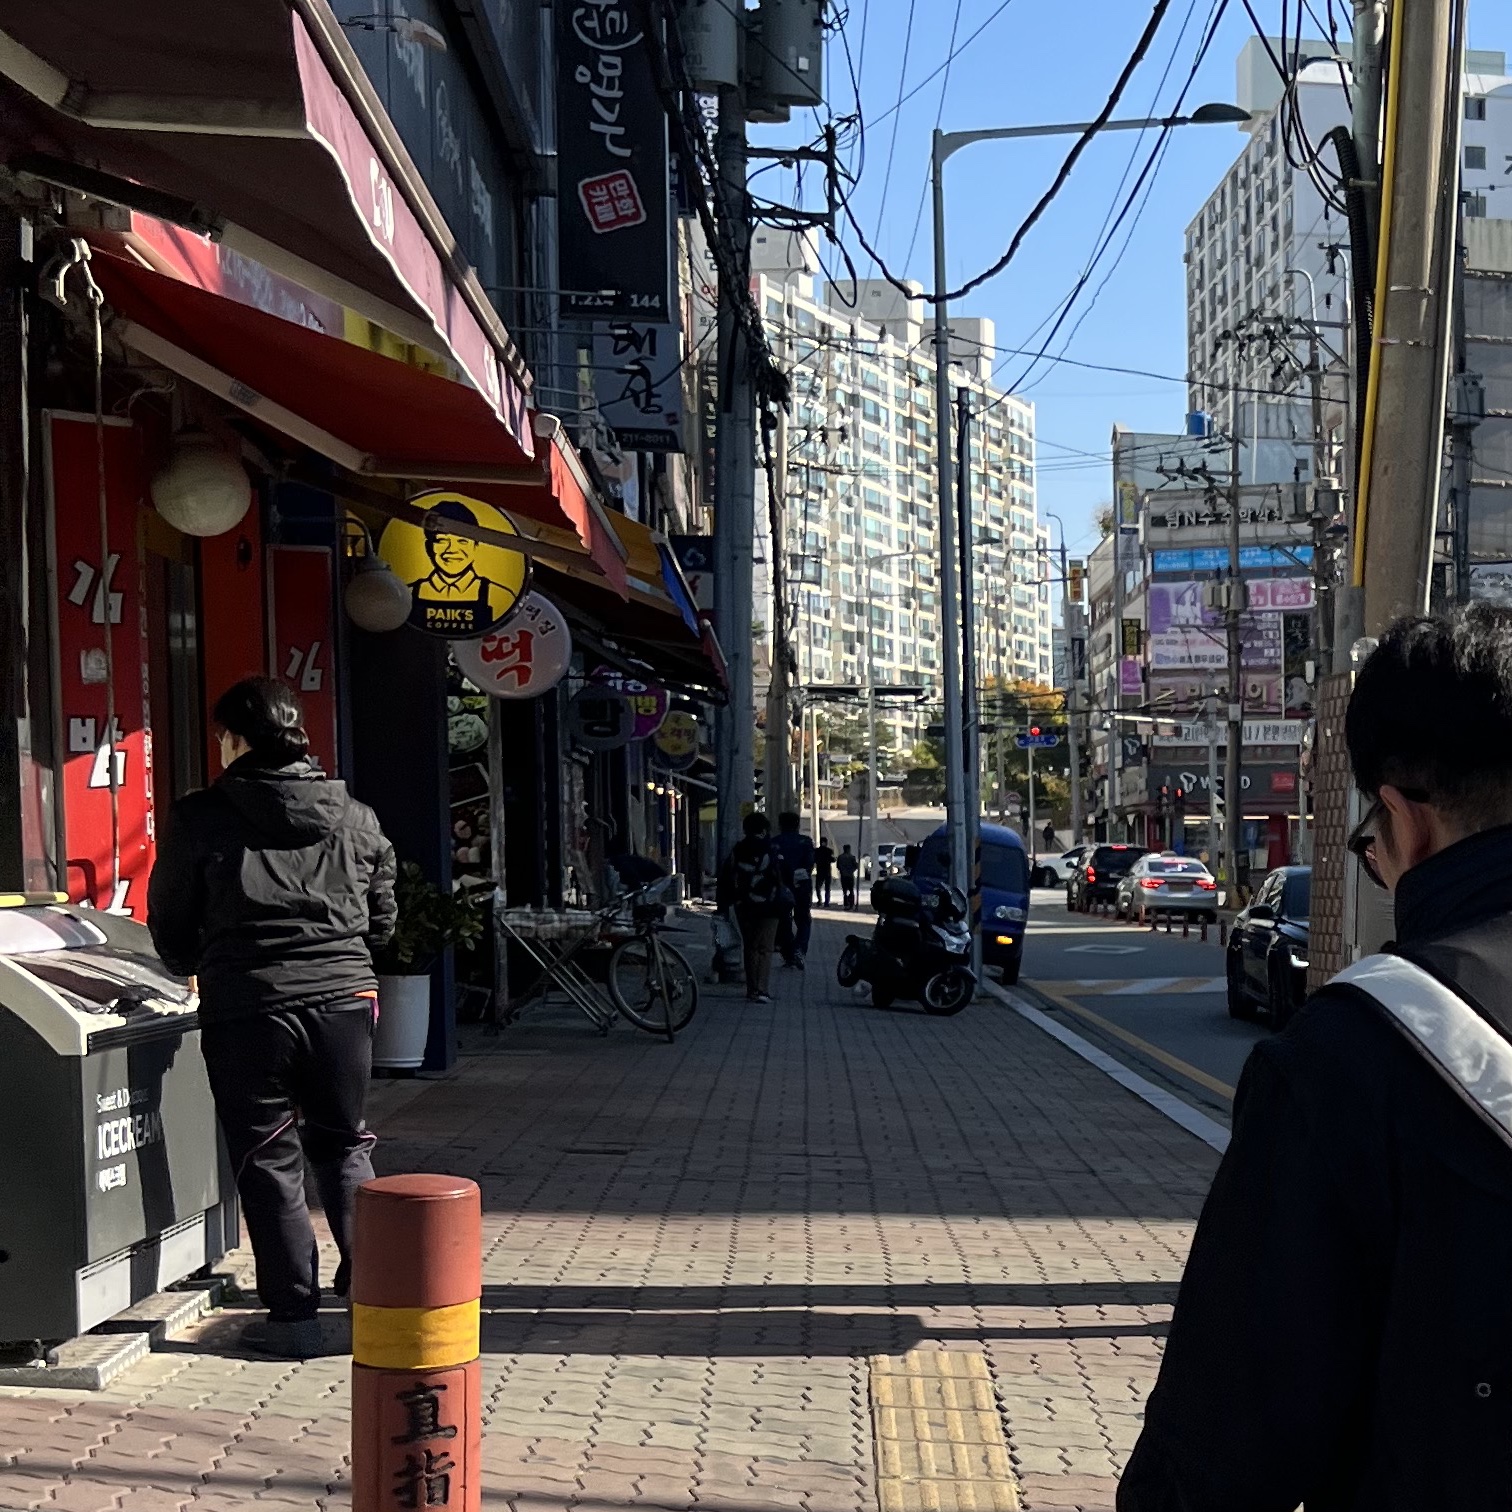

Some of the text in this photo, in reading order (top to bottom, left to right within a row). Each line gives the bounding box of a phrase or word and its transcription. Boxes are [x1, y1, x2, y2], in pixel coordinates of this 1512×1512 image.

[425, 607, 474, 621] PAIK'S
[426, 621, 474, 630] COFFEE
[97, 1111, 163, 1160] ICECREAM
